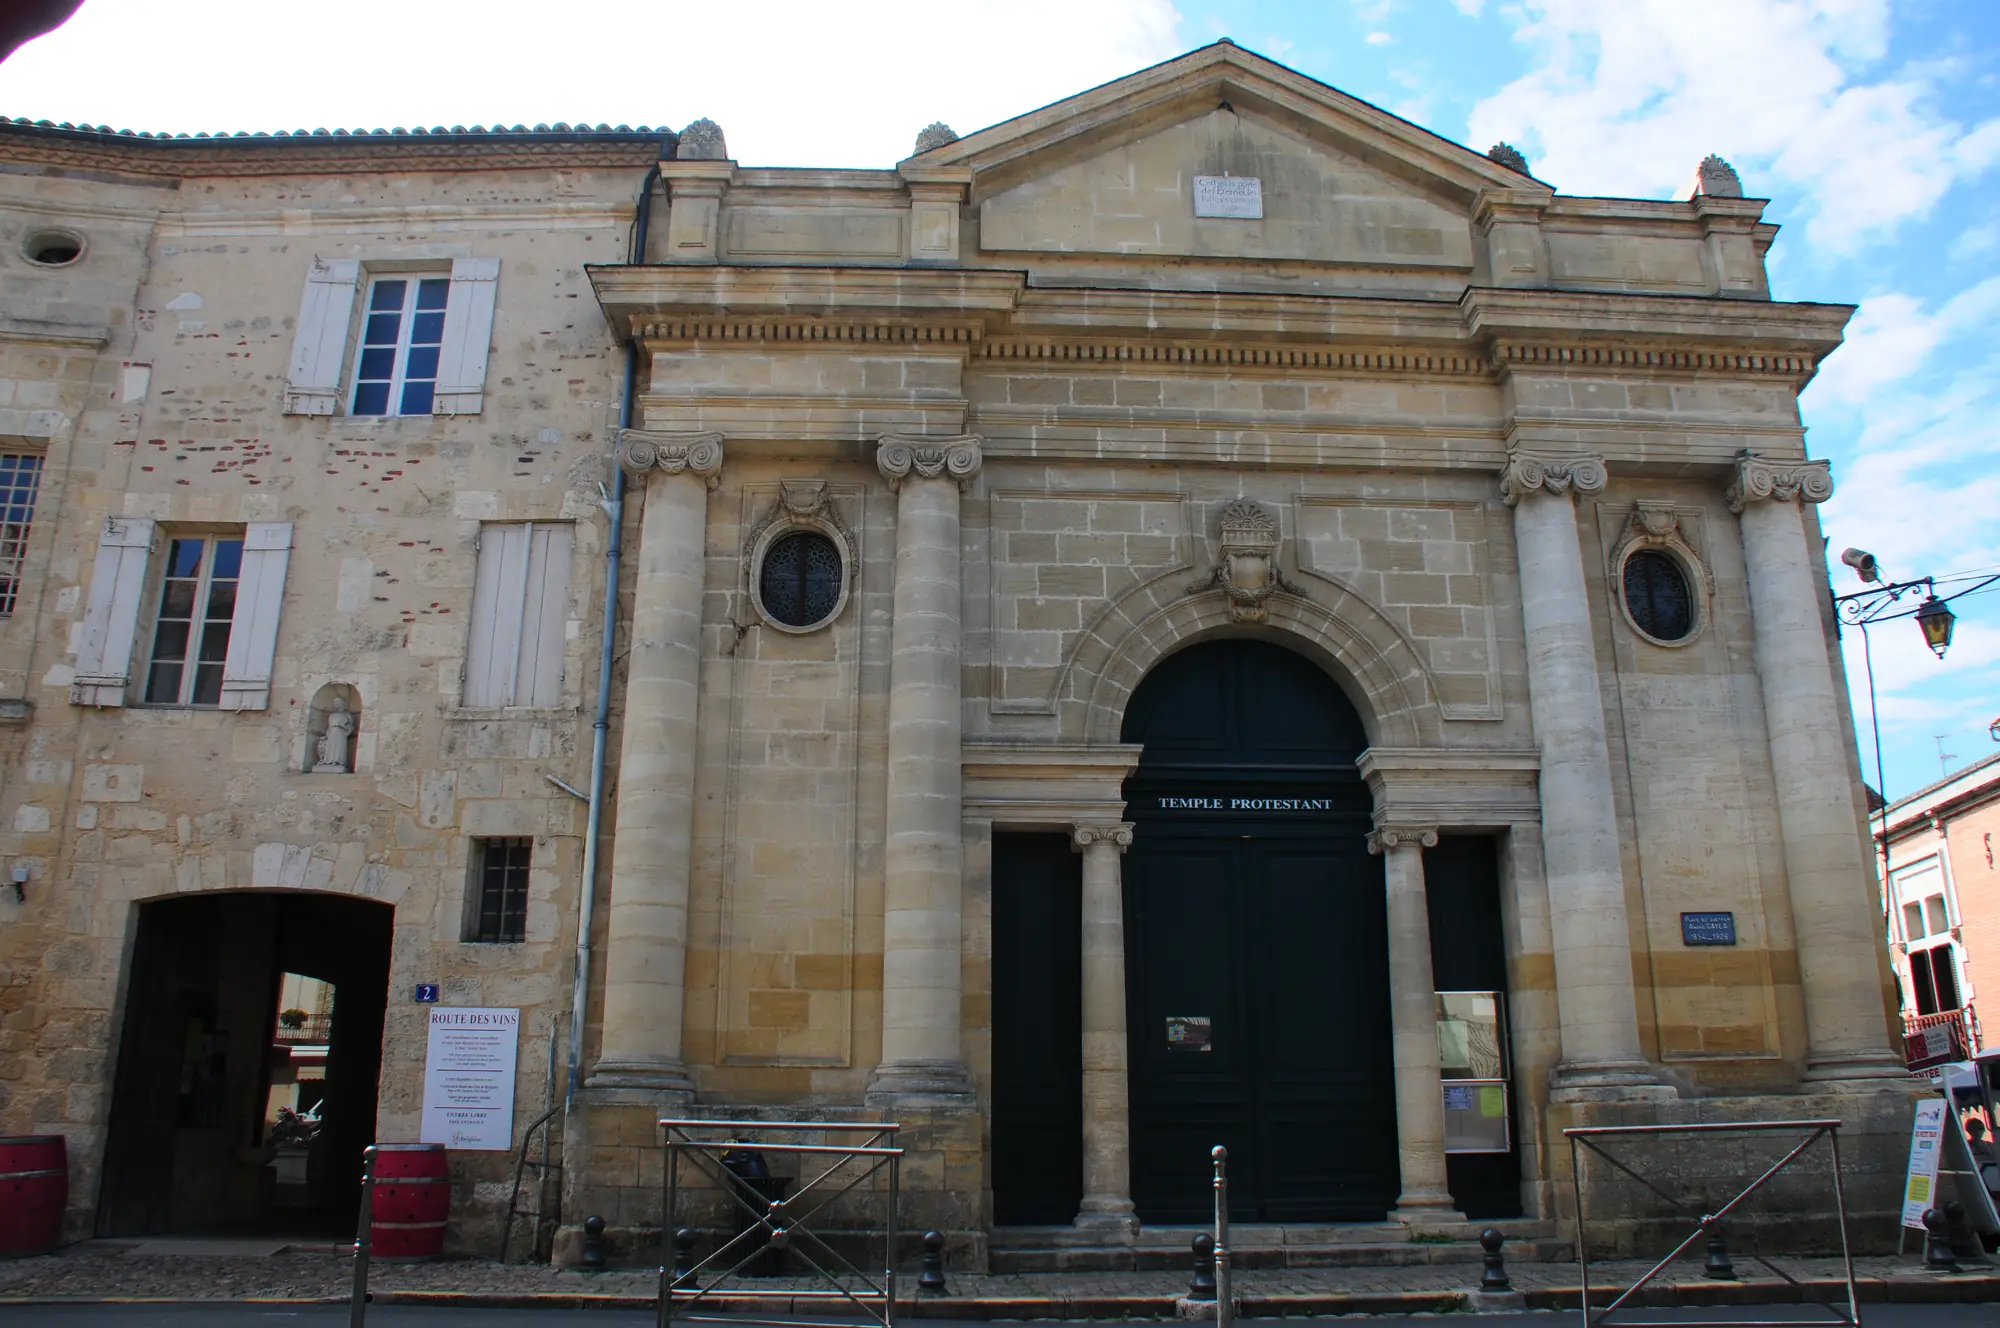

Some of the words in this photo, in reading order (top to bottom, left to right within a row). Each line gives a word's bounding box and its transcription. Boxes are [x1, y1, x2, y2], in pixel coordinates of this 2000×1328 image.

[1158, 797, 1223, 809] TEMPLE
[1230, 798, 1332, 810] PROTESTANT
[423, 986, 431, 1000] 2
[431, 1013, 467, 1024] ROUTE
[470, 1014, 489, 1025] DES
[493, 1014, 517, 1025] VINS
